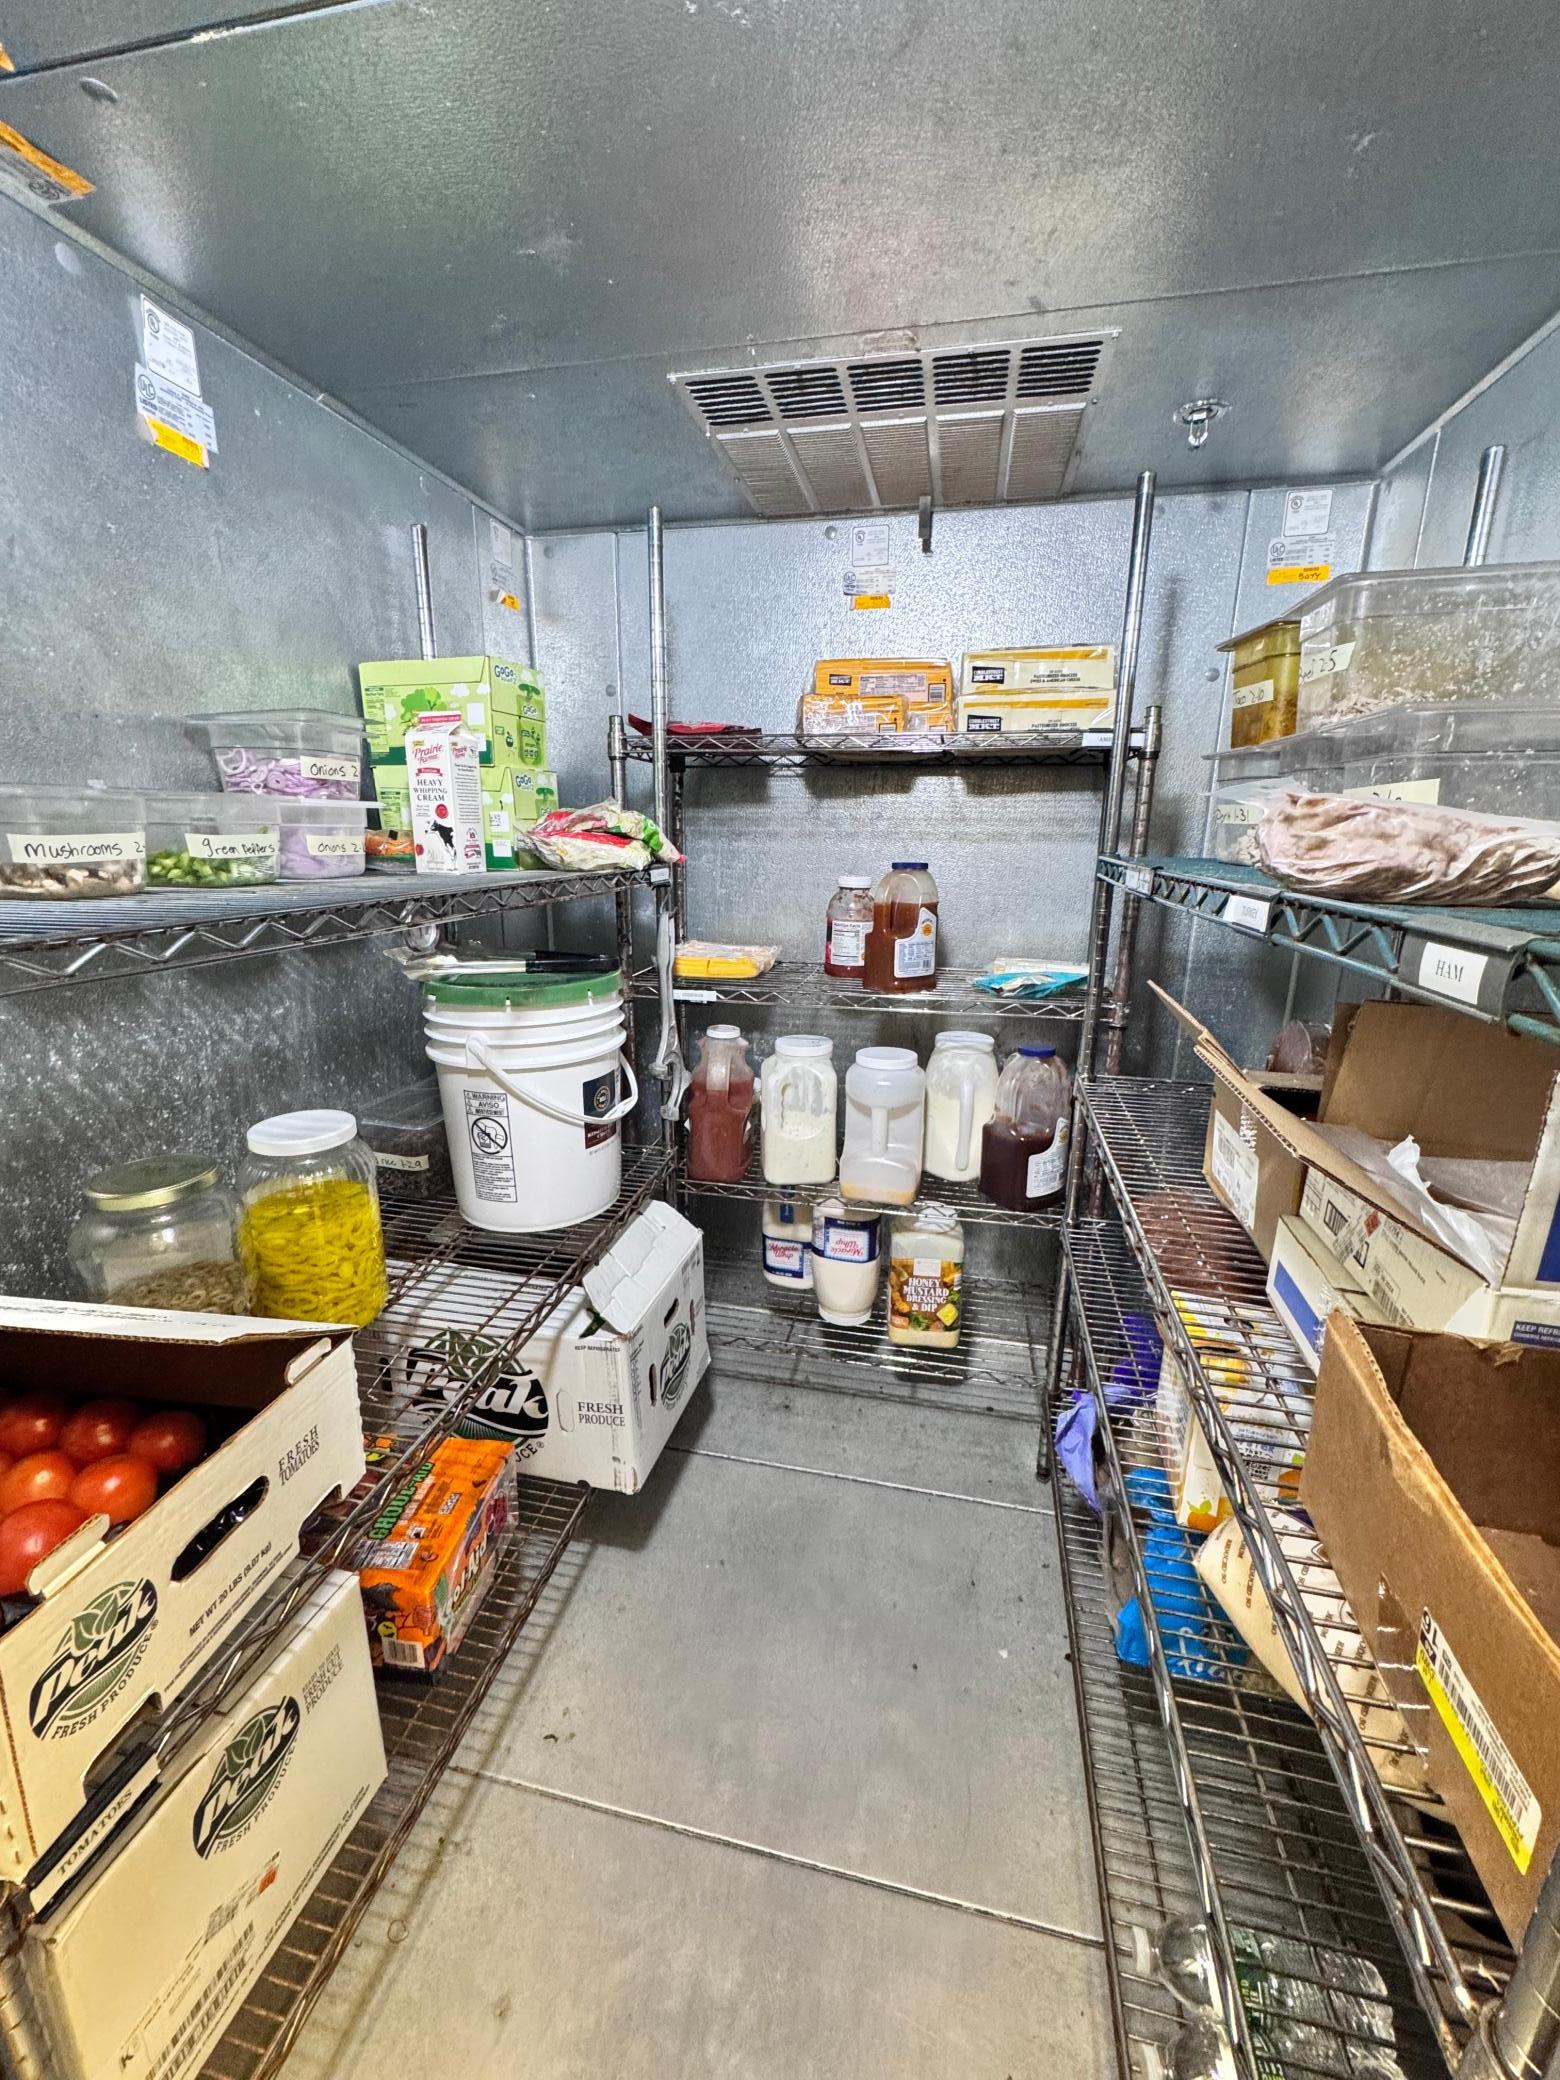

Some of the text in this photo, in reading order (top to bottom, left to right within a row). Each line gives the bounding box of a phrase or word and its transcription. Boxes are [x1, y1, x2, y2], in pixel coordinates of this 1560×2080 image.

[412, 743, 443, 759] Prairie
[310, 763, 347, 776] Onions
[417, 779, 443, 787] HEAVY
[416, 793, 446, 802] CREAM
[24, 842, 124, 860] Mushrooms
[202, 838, 240, 857] green
[1435, 960, 1464, 982] HAM
[472, 1093, 506, 1102] WARNING
[478, 1101, 500, 1109] AVISO
[908, 1277, 941, 1287] HONEY
[903, 1286, 950, 1297] MUSTARD
[906, 1294, 947, 1304] DRESSING
[911, 1303, 938, 1312] & DIP
[1515, 1323, 1537, 1333] KEEP
[577, 1401, 624, 1415] FRESH
[578, 1413, 626, 1427] PRODUCE
[278, 1424, 319, 1472] FRESH
[279, 1440, 320, 1487] TOMATOES
[188, 1614, 205, 1637] NET
[205, 1599, 219, 1618] WT
[218, 1589, 228, 1605] 20
[228, 1574, 243, 1595] LBS
[51, 1632, 153, 1741] FRESH PRODUCE
[213, 1745, 296, 1855] FRESH PRODUCE
[57, 1788, 133, 1876] TOMATOES
